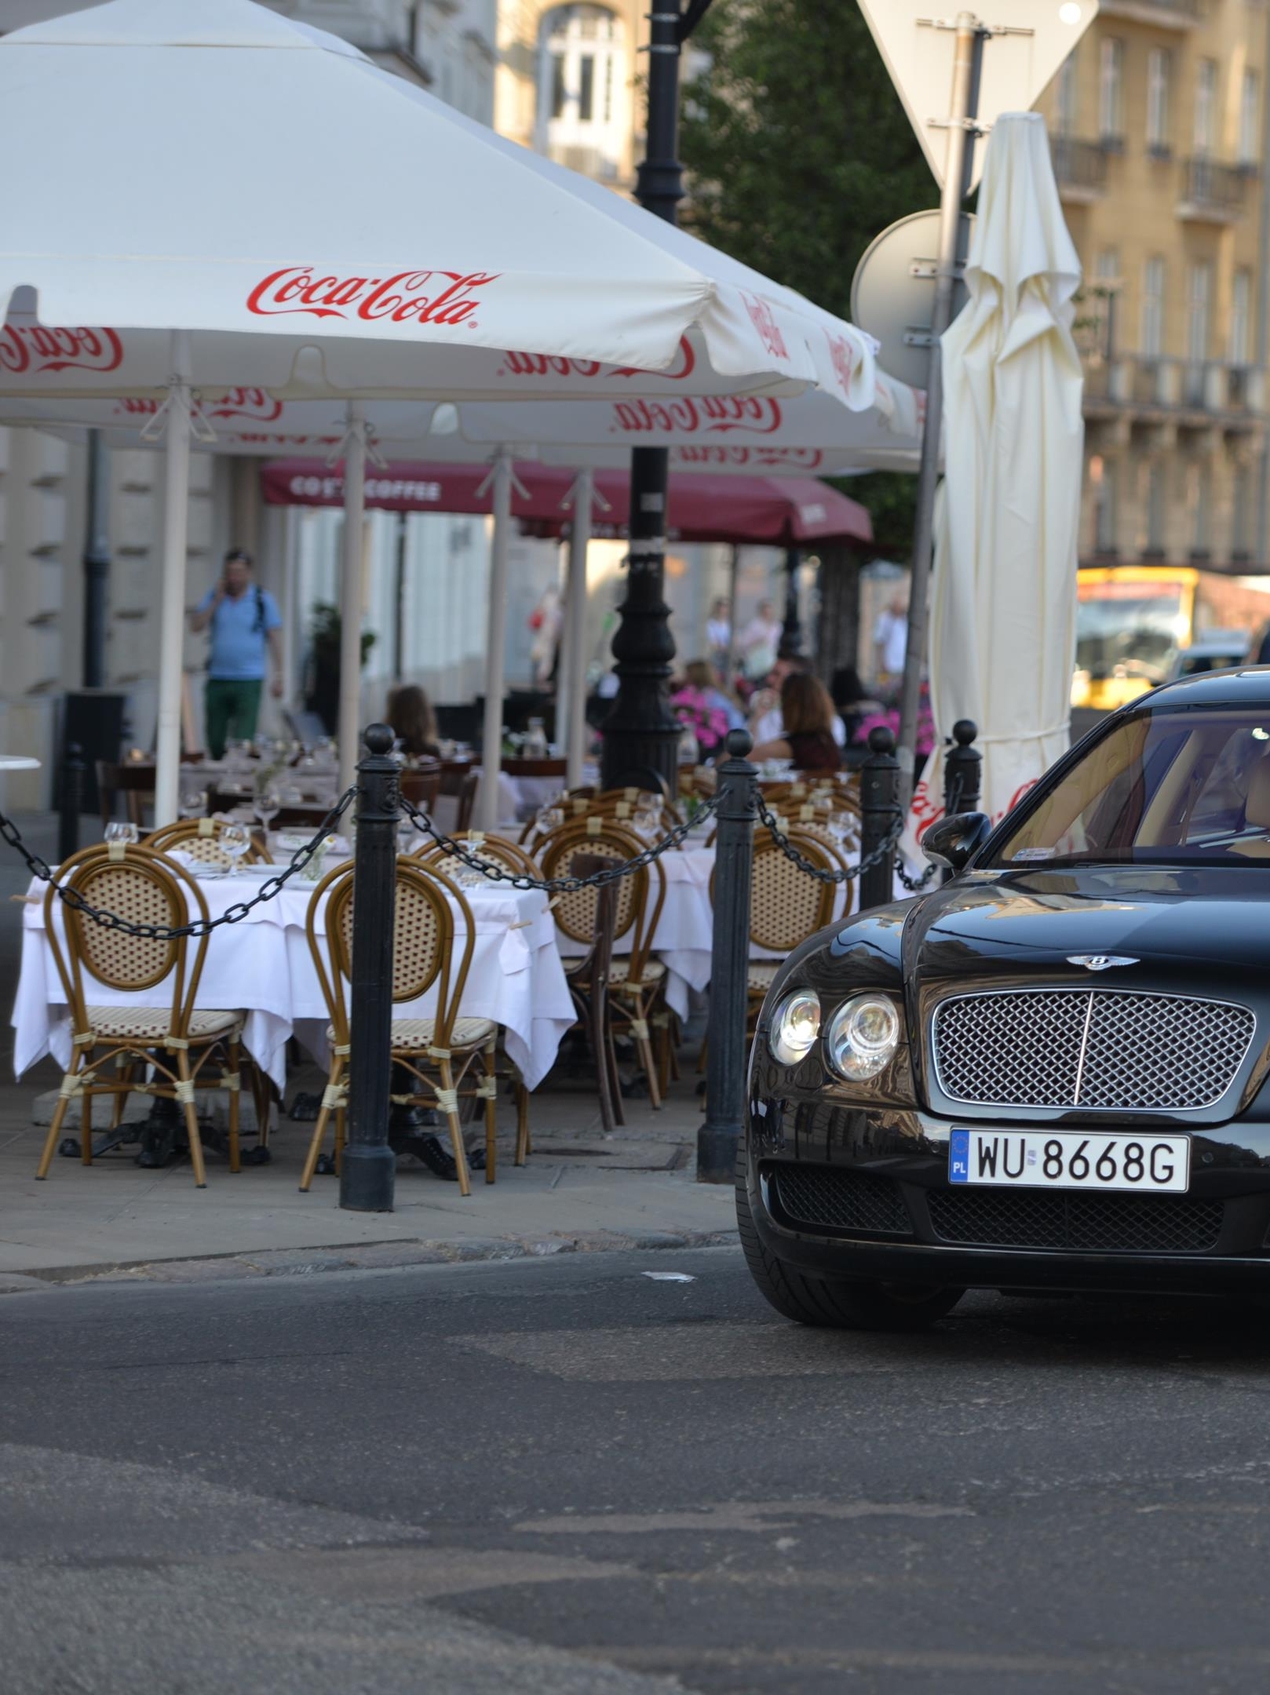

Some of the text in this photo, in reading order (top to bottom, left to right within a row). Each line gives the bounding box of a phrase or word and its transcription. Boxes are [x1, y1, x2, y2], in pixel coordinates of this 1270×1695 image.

[246, 266, 504, 326] Coca-Cola
[364, 478, 441, 501] COFFEE
[953, 1161, 967, 1174] PL
[977, 1137, 1175, 1184] WU 8668G
